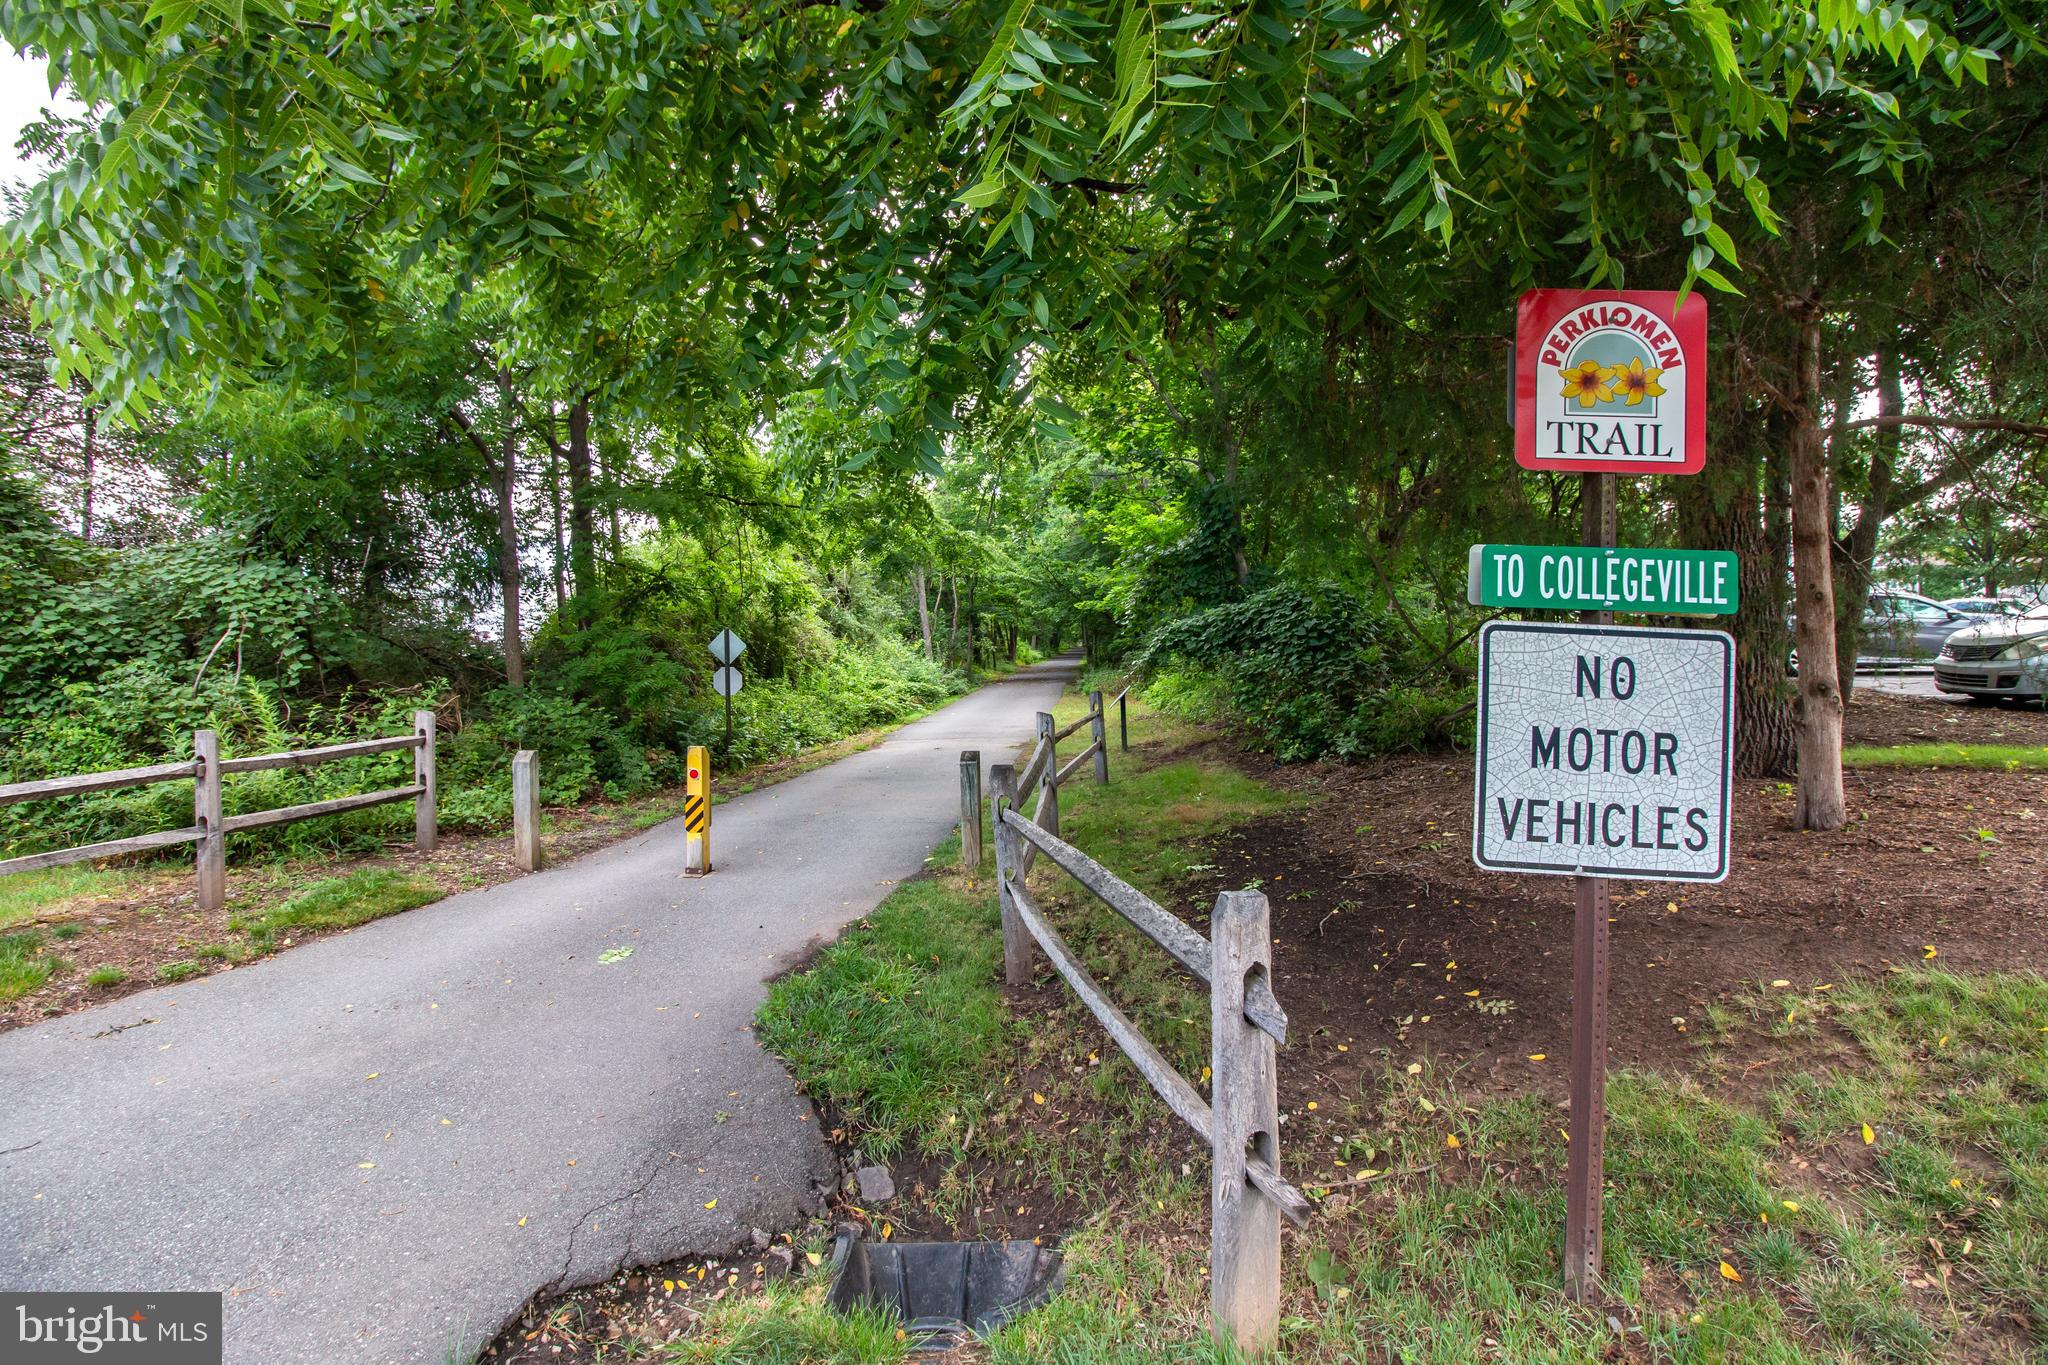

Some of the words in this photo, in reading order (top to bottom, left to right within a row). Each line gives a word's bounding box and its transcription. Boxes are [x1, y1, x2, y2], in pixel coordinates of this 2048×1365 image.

[1541, 306, 1682, 370] PERKIOMEN
[1546, 420, 1673, 458] TRAIL
[1493, 554, 1525, 598] TO
[1539, 555, 1728, 605] COLLEGEVILLE
[1576, 655, 1636, 701] NO
[1530, 725, 1679, 776] MOTOR
[1497, 797, 1709, 851] VEHICLES
